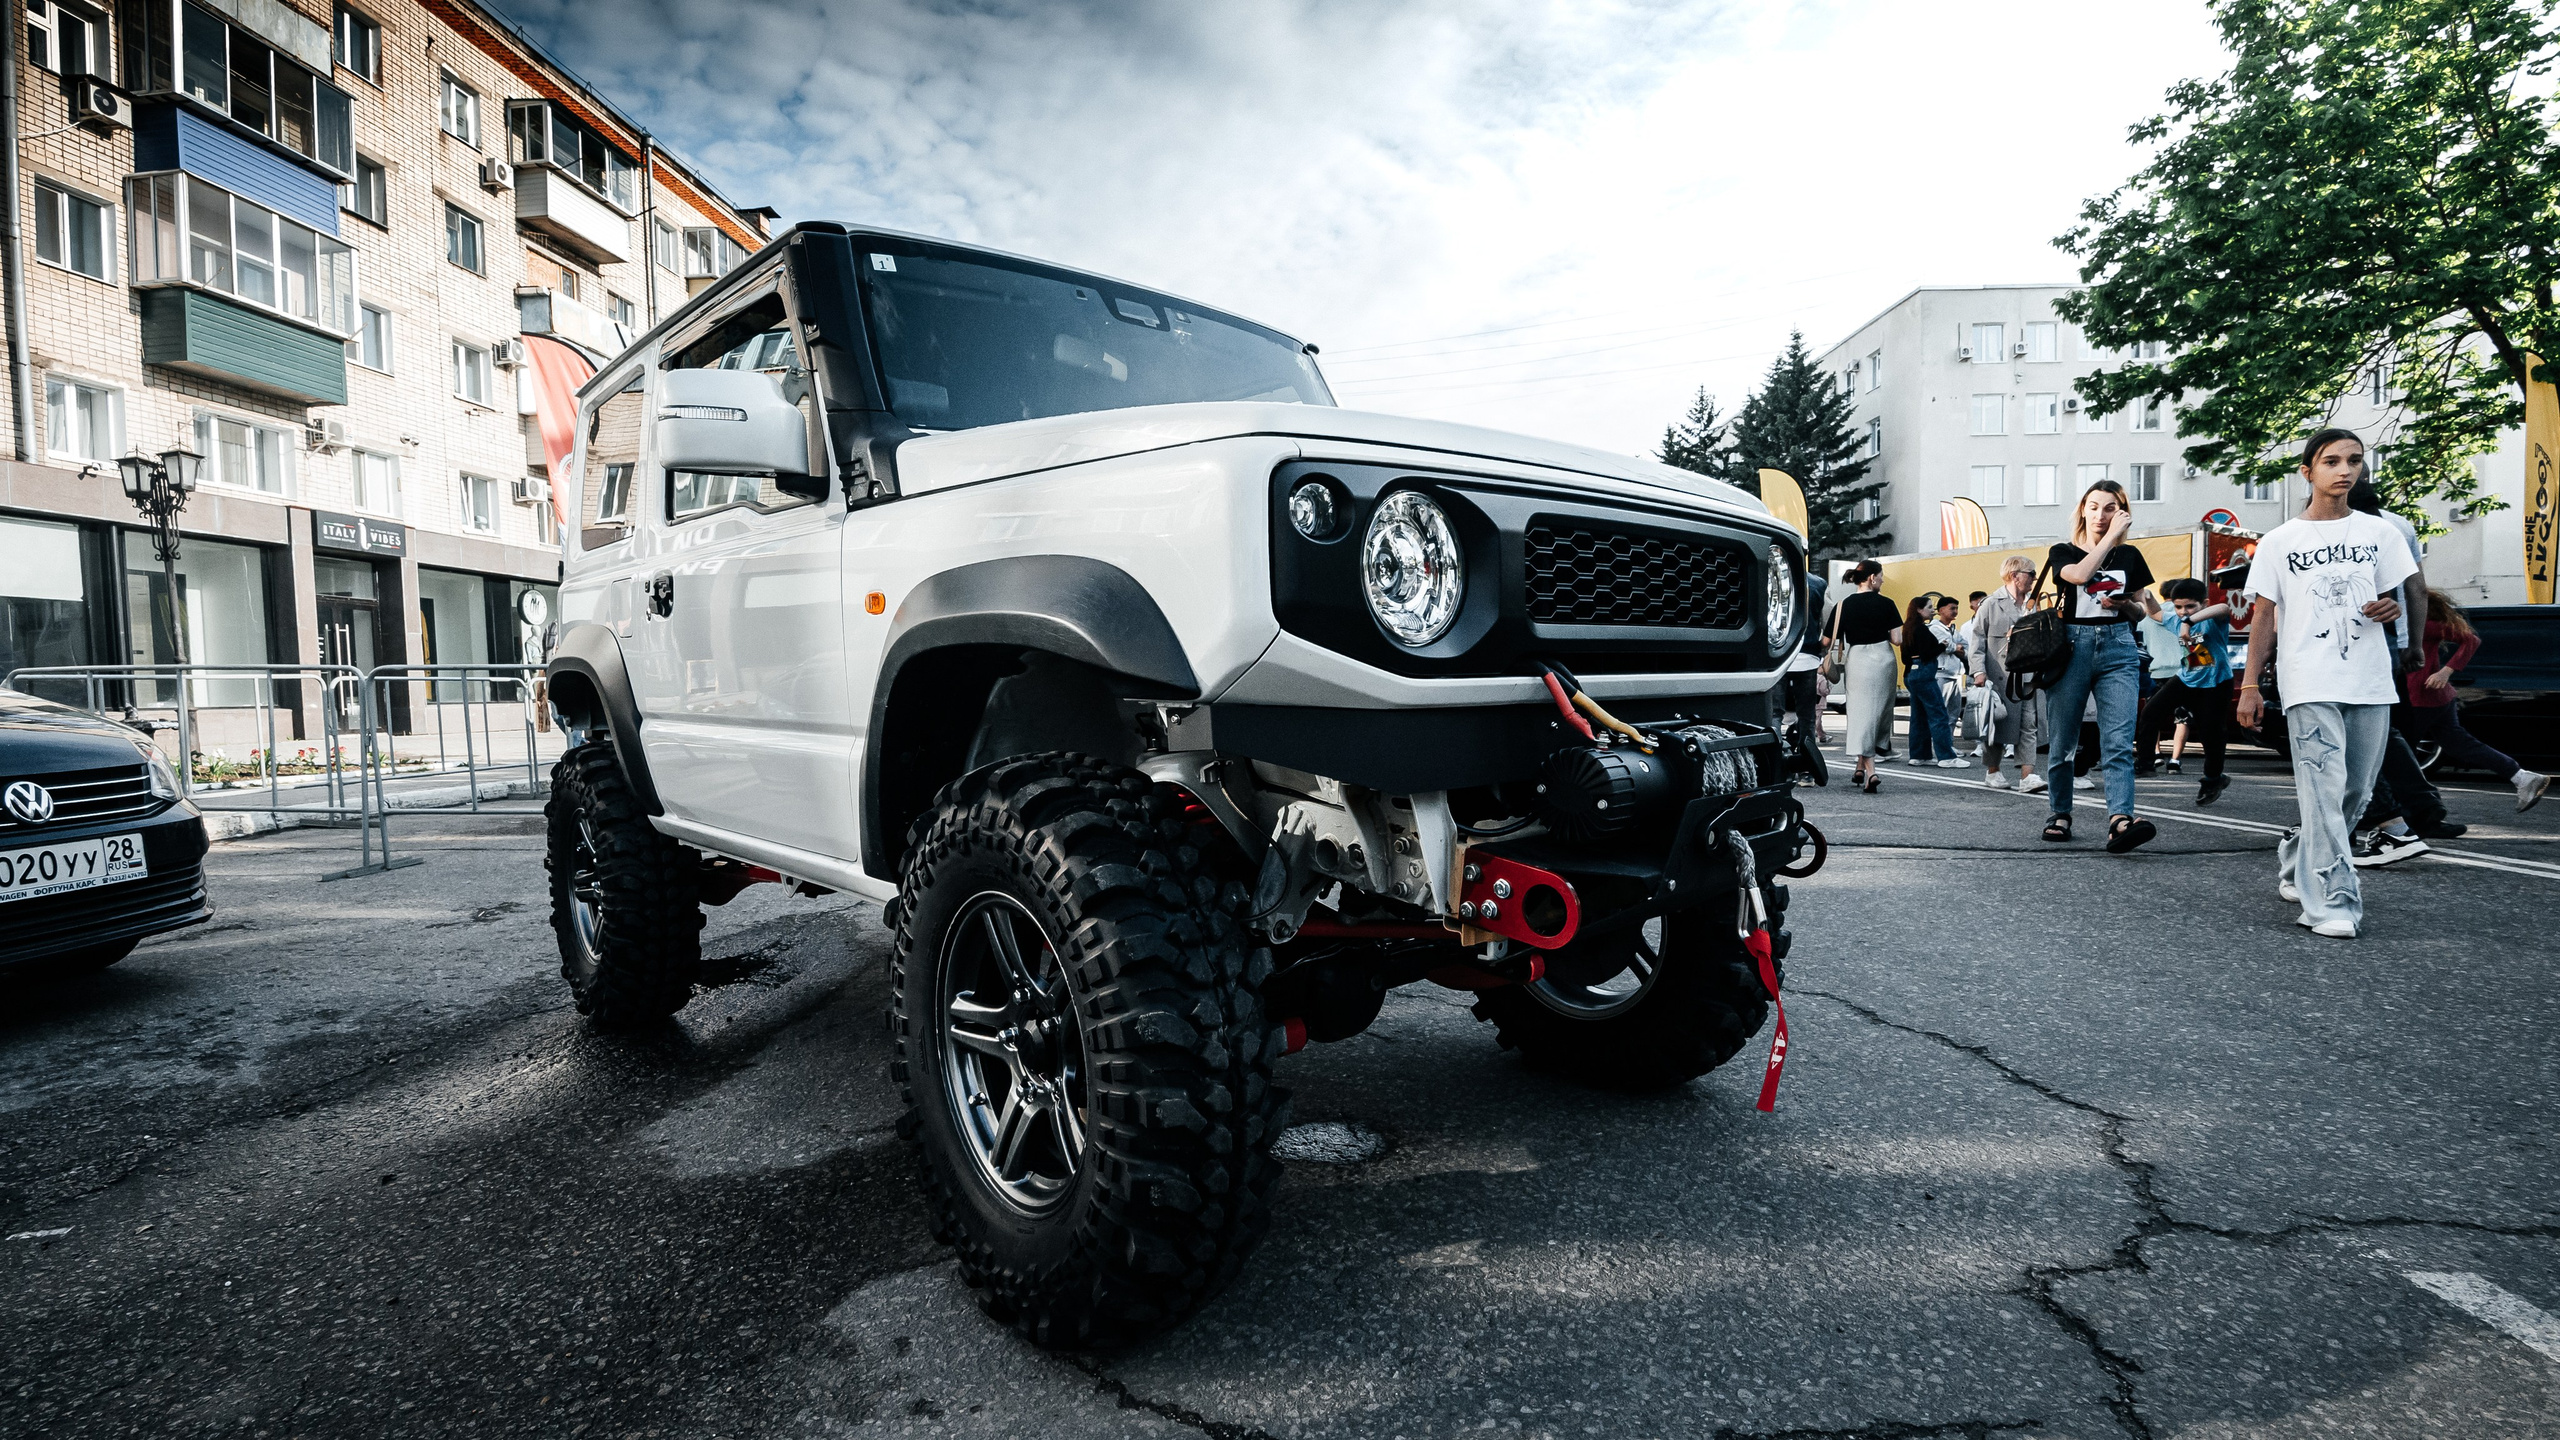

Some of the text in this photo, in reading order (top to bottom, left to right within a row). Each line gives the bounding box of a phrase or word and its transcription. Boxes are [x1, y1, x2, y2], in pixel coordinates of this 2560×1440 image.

[322, 525, 356, 538] ITALY
[370, 532, 402, 546] VIBES
[2286, 543, 2379, 576] RECKLESS
[107, 838, 134, 862] 28
[108, 860, 128, 872] RUS
[33, 883, 75, 896] ФОРТУНА
[76, 879, 97, 889] КАРС
